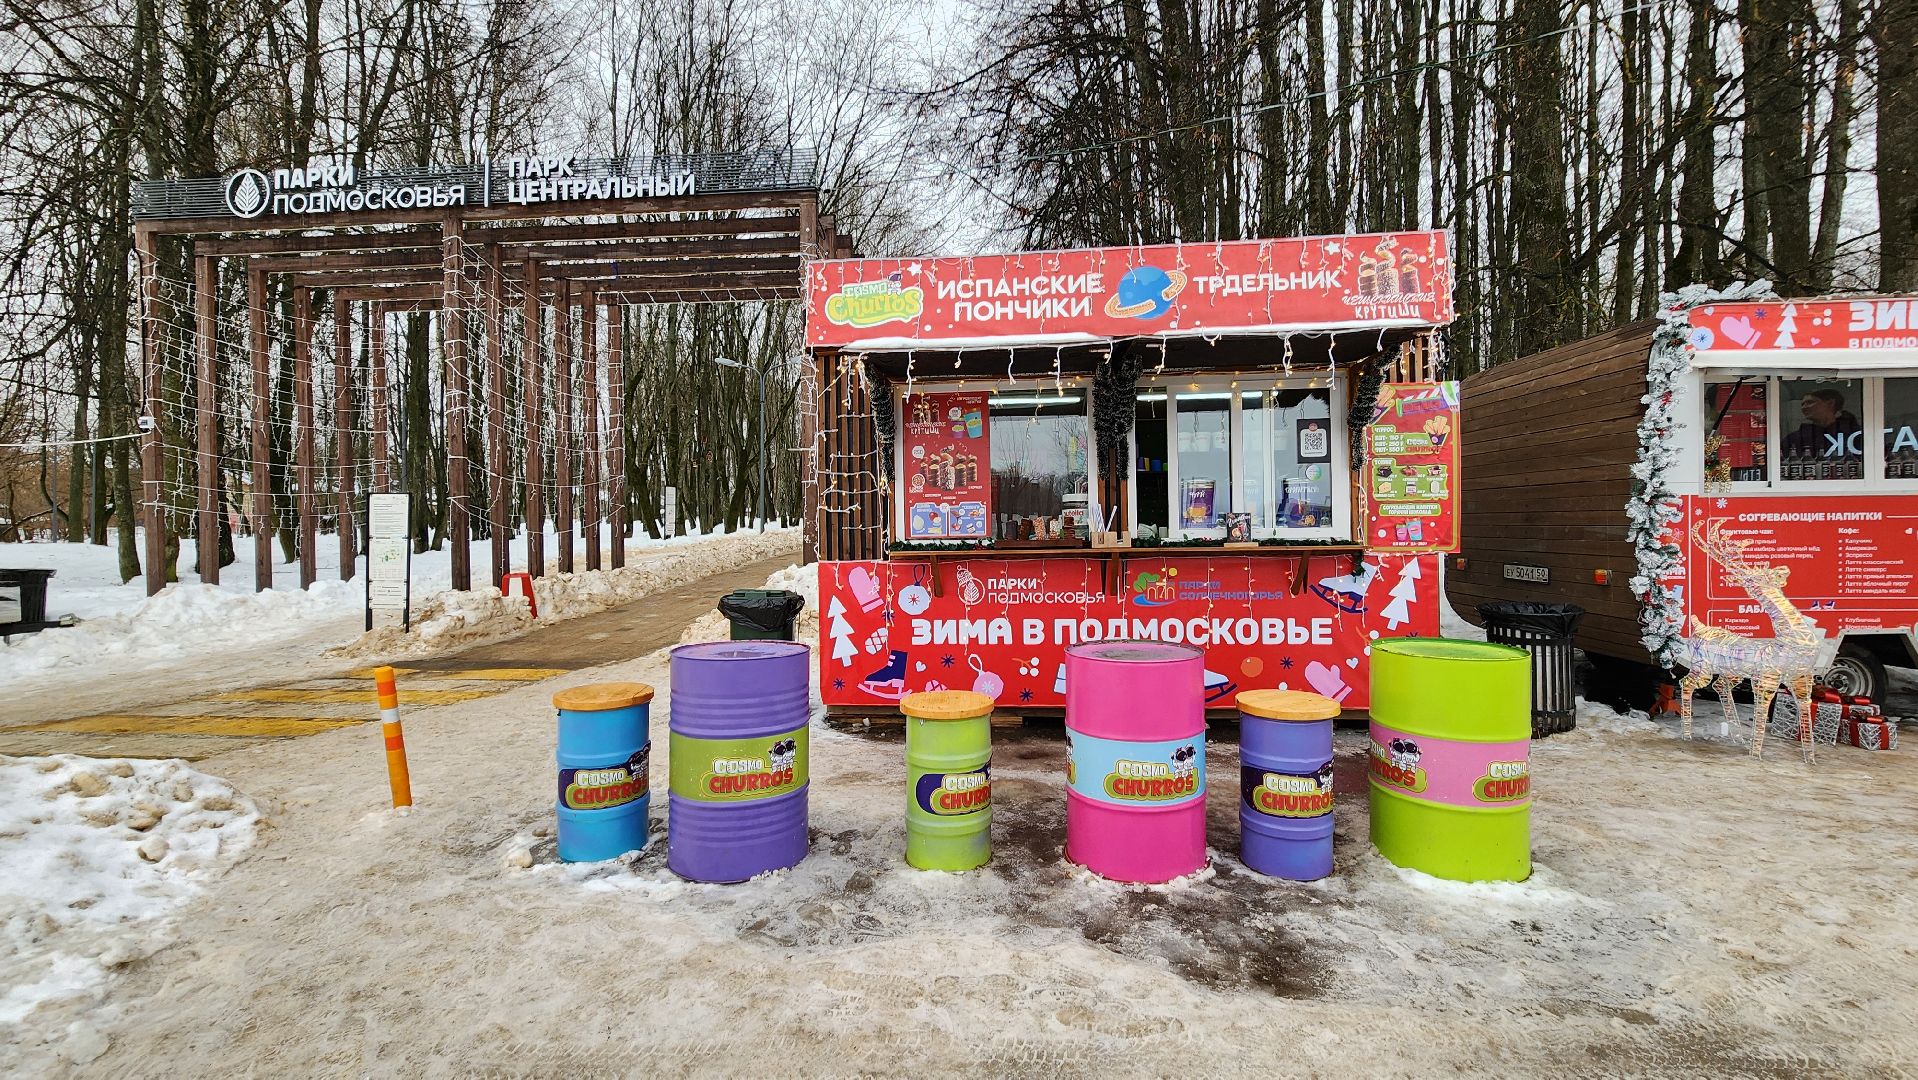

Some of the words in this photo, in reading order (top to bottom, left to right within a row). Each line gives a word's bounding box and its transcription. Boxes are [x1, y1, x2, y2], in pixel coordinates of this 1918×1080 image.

[508, 156, 574, 178] ПАРК
[274, 165, 354, 190] ПАРКИ
[508, 169, 695, 206] ЦЕНТРАЛЬНЫЙ
[273, 184, 465, 215] ПОДМОСКОВЬЯ
[846, 282, 887, 298] COSMO
[937, 272, 1105, 300] ИСПАНСКИЕ
[1192, 269, 1342, 297] ТРДЕЛЬНИК
[954, 297, 1092, 322] ПОНЧИКИ
[1355, 304, 1420, 319] КРУТИШИ
[1849, 338, 1860, 349] В
[1862, 336, 1918, 348] ПОДМО
[1738, 513, 1825, 522] СОГРЕВАЮЩИЕ
[1827, 512, 1882, 521] НАПИТКИ
[987, 578, 1037, 590] ПАРКИ
[1179, 581, 1221, 590] ПАРКИ
[988, 591, 1105, 605] ПОДМОСКОВЬЯ
[912, 617, 1012, 646] ЗИМА
[1023, 618, 1045, 645] В
[1054, 617, 1333, 645] ПОДМОСКОВЬЕ
[714, 759, 763, 774] COSMO
[1118, 762, 1167, 777] COSMO
[577, 771, 624, 786] COSMO
[709, 768, 794, 793] CHURROS
[946, 775, 985, 791] COSMO
[1113, 774, 1193, 796] CHURROS
[1266, 776, 1314, 793] COSMO
[939, 785, 991, 809] CHURR
